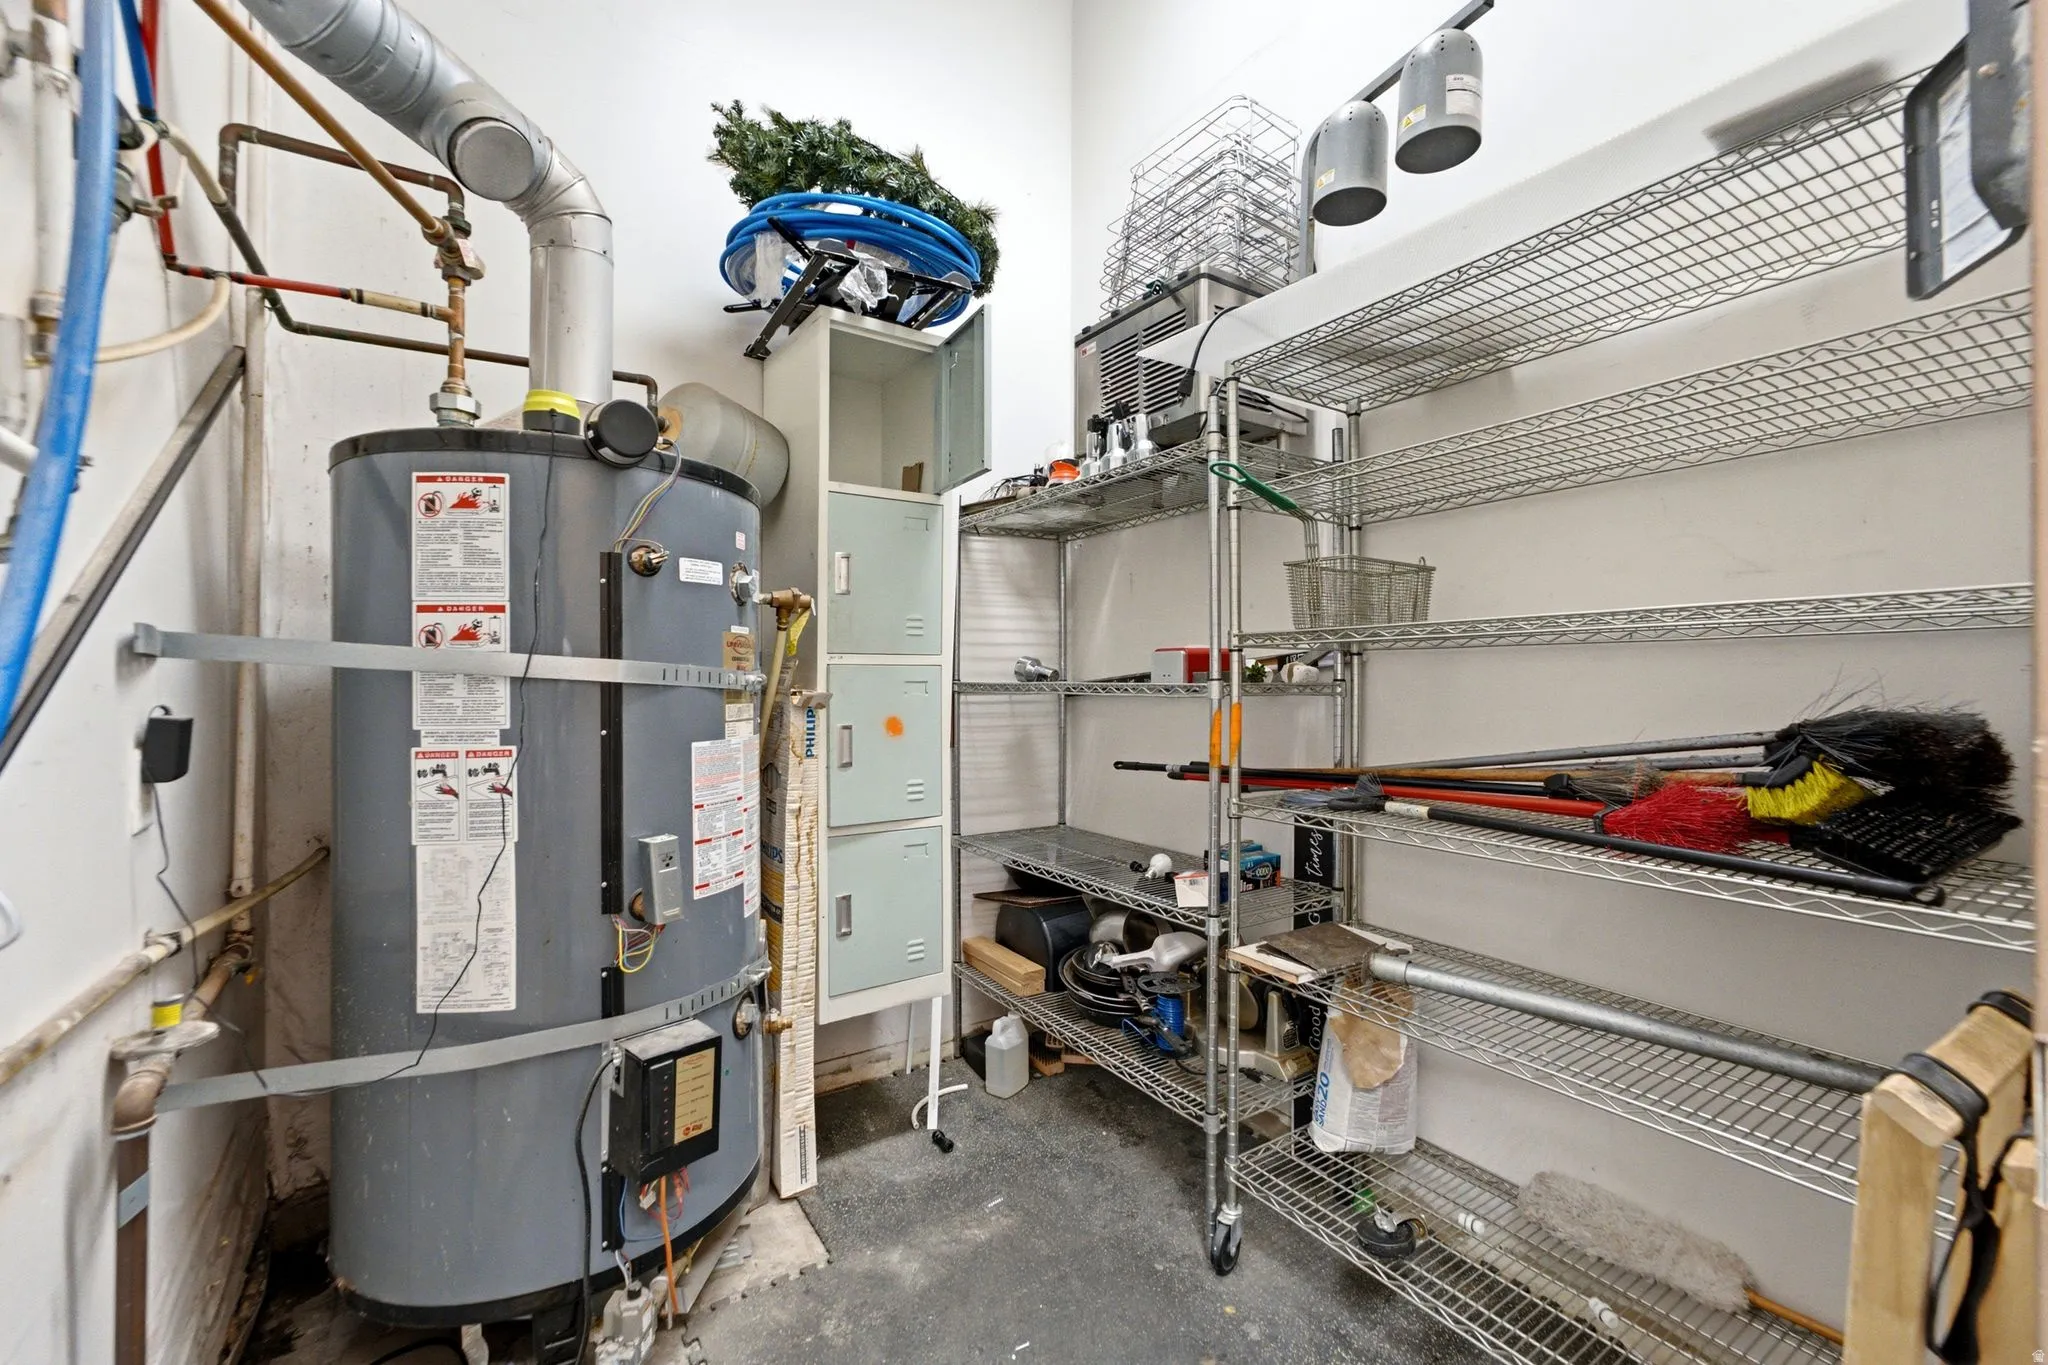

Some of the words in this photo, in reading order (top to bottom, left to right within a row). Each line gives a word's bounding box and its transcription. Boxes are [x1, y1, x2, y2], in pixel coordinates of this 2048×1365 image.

[805, 706, 816, 758] PHILIP
[1304, 828, 1323, 877] times
[1308, 1004, 1321, 1050] Good
[1318, 1071, 1330, 1101] 20
